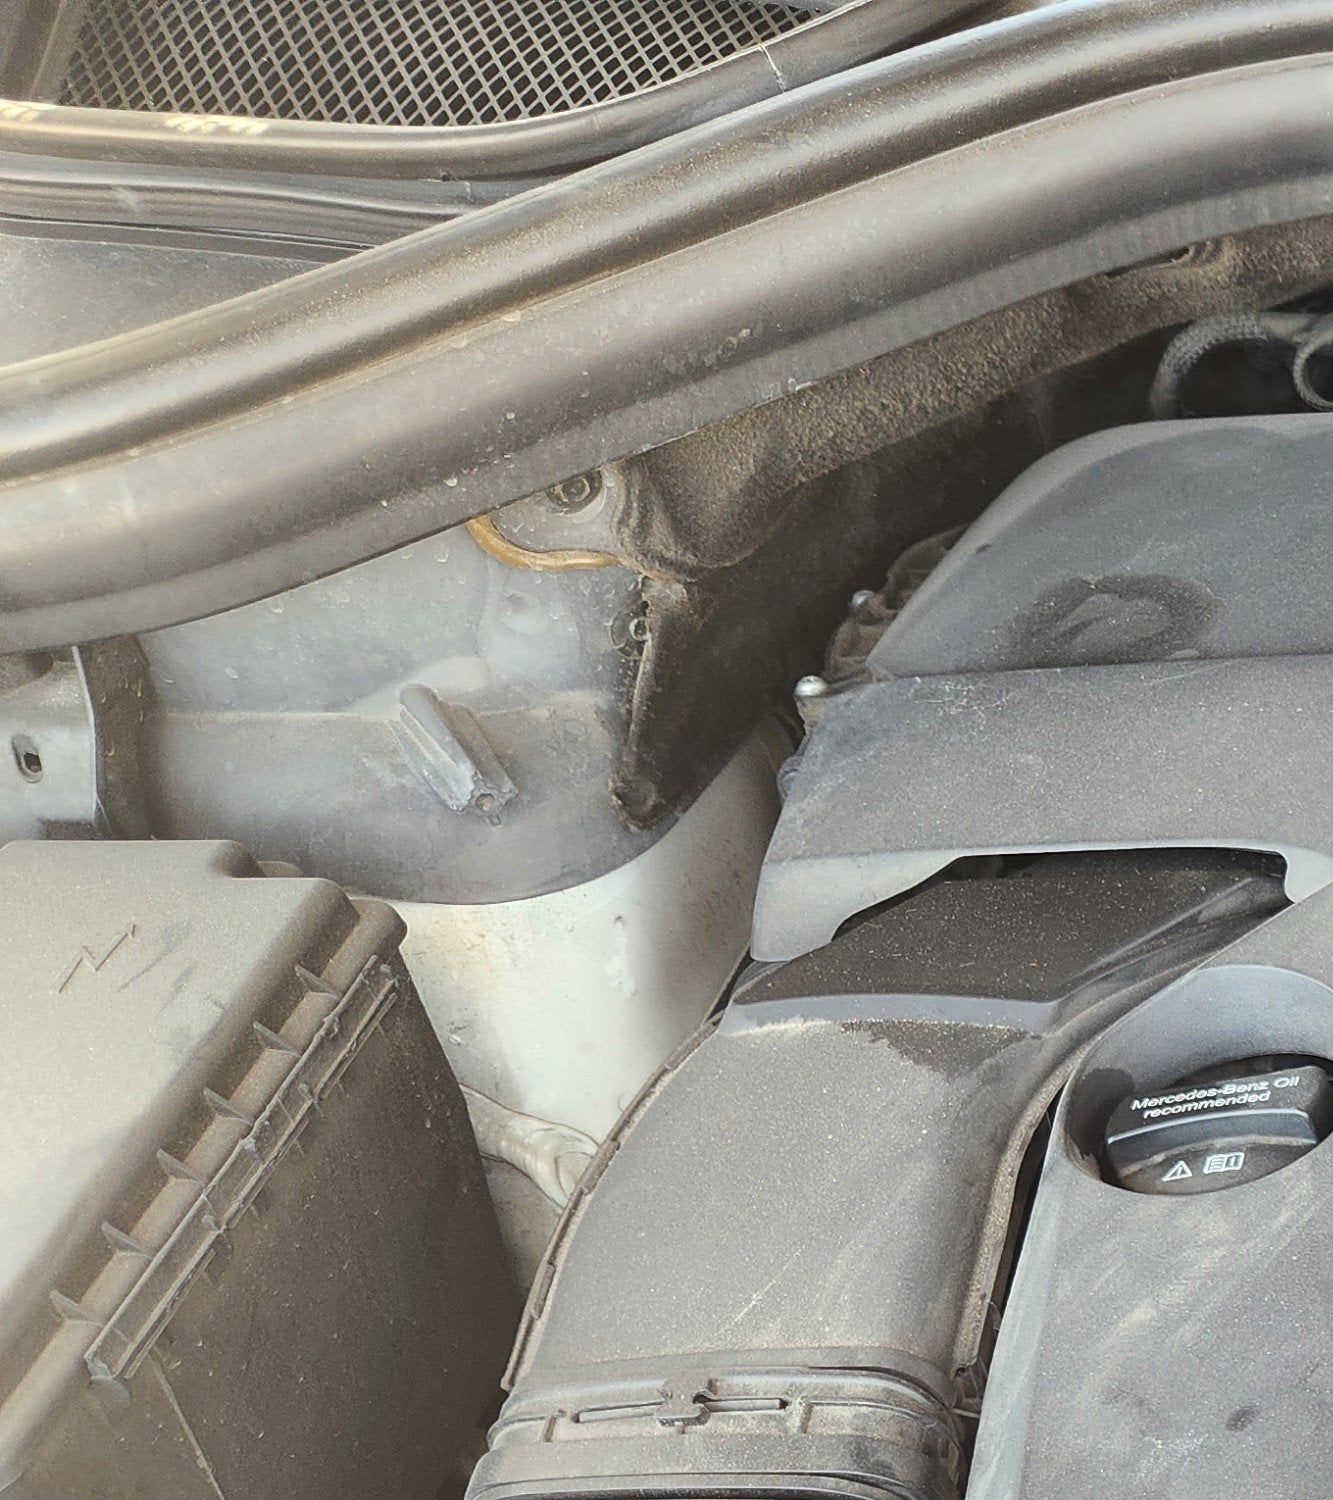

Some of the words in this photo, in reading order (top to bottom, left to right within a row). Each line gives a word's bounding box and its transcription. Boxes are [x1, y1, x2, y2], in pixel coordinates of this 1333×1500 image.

[1130, 1079, 1270, 1111] Mercedes-Benz
[1272, 1075, 1301, 1090] Oil
[1141, 1090, 1271, 1120] recommended
